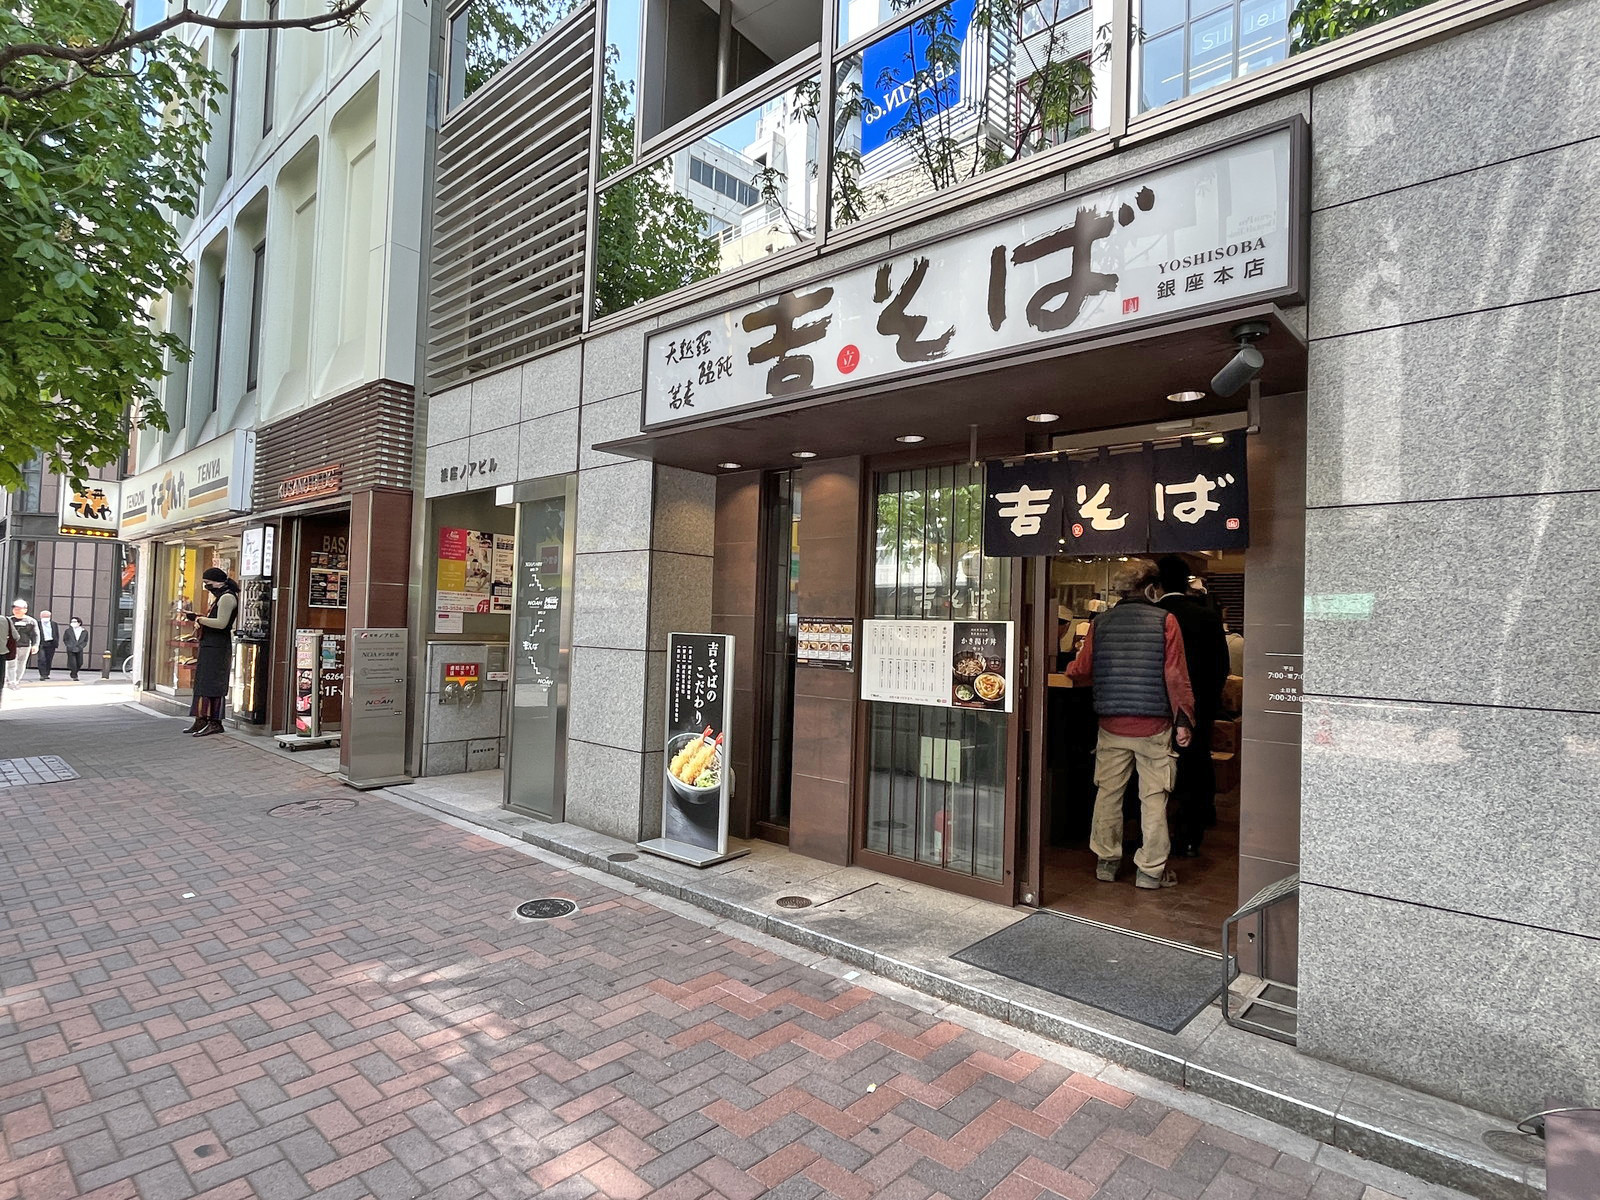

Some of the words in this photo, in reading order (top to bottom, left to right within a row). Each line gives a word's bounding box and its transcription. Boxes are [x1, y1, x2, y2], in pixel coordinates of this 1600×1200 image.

[1158, 237, 1266, 274] YOSHISOBA
[740, 185, 1156, 398] 吉そば
[1156, 257, 1265, 300] 銀座本店
[197, 457, 221, 484] TENYA
[69, 502, 112, 521] てんや
[126, 489, 146, 510] TENDON
[995, 474, 1235, 537] 吉そば
[478, 604, 489, 613] 7F
[706, 641, 719, 702] 吉そばの
[324, 685, 338, 697] 1F
[365, 696, 394, 706] NOAH
[694, 666, 705, 725] こだわり
